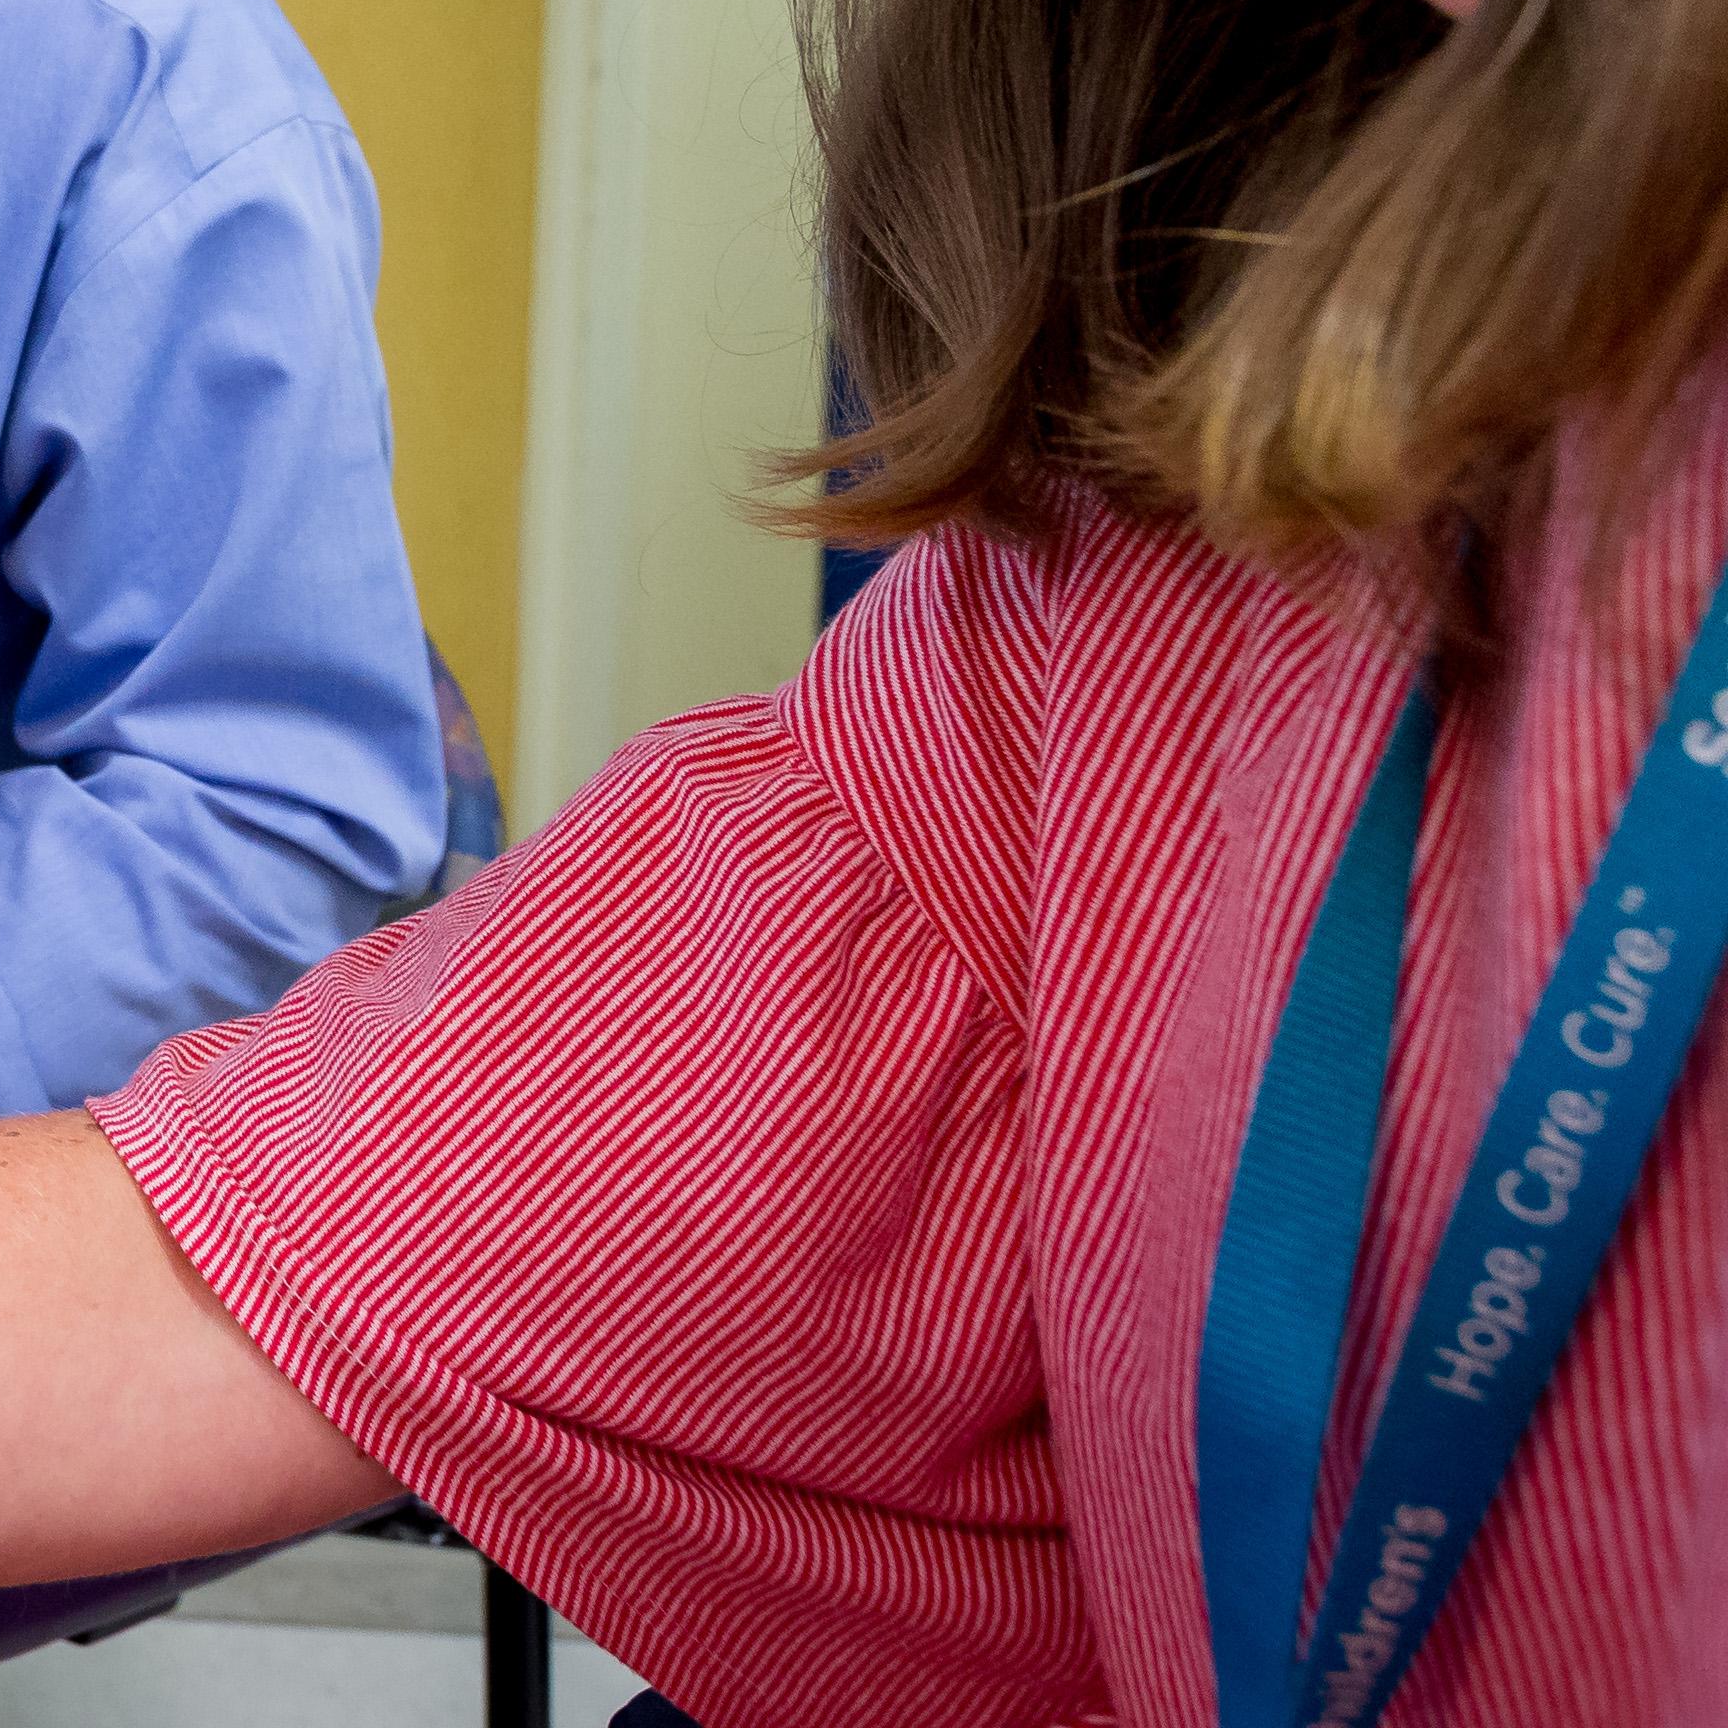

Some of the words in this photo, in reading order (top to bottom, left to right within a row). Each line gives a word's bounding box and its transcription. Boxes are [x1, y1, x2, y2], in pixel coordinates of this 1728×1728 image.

[1427, 1245, 1547, 1403] Hope.
[1495, 1088, 1611, 1227] Care.
[1308, 1503, 1449, 1728] ildren's
